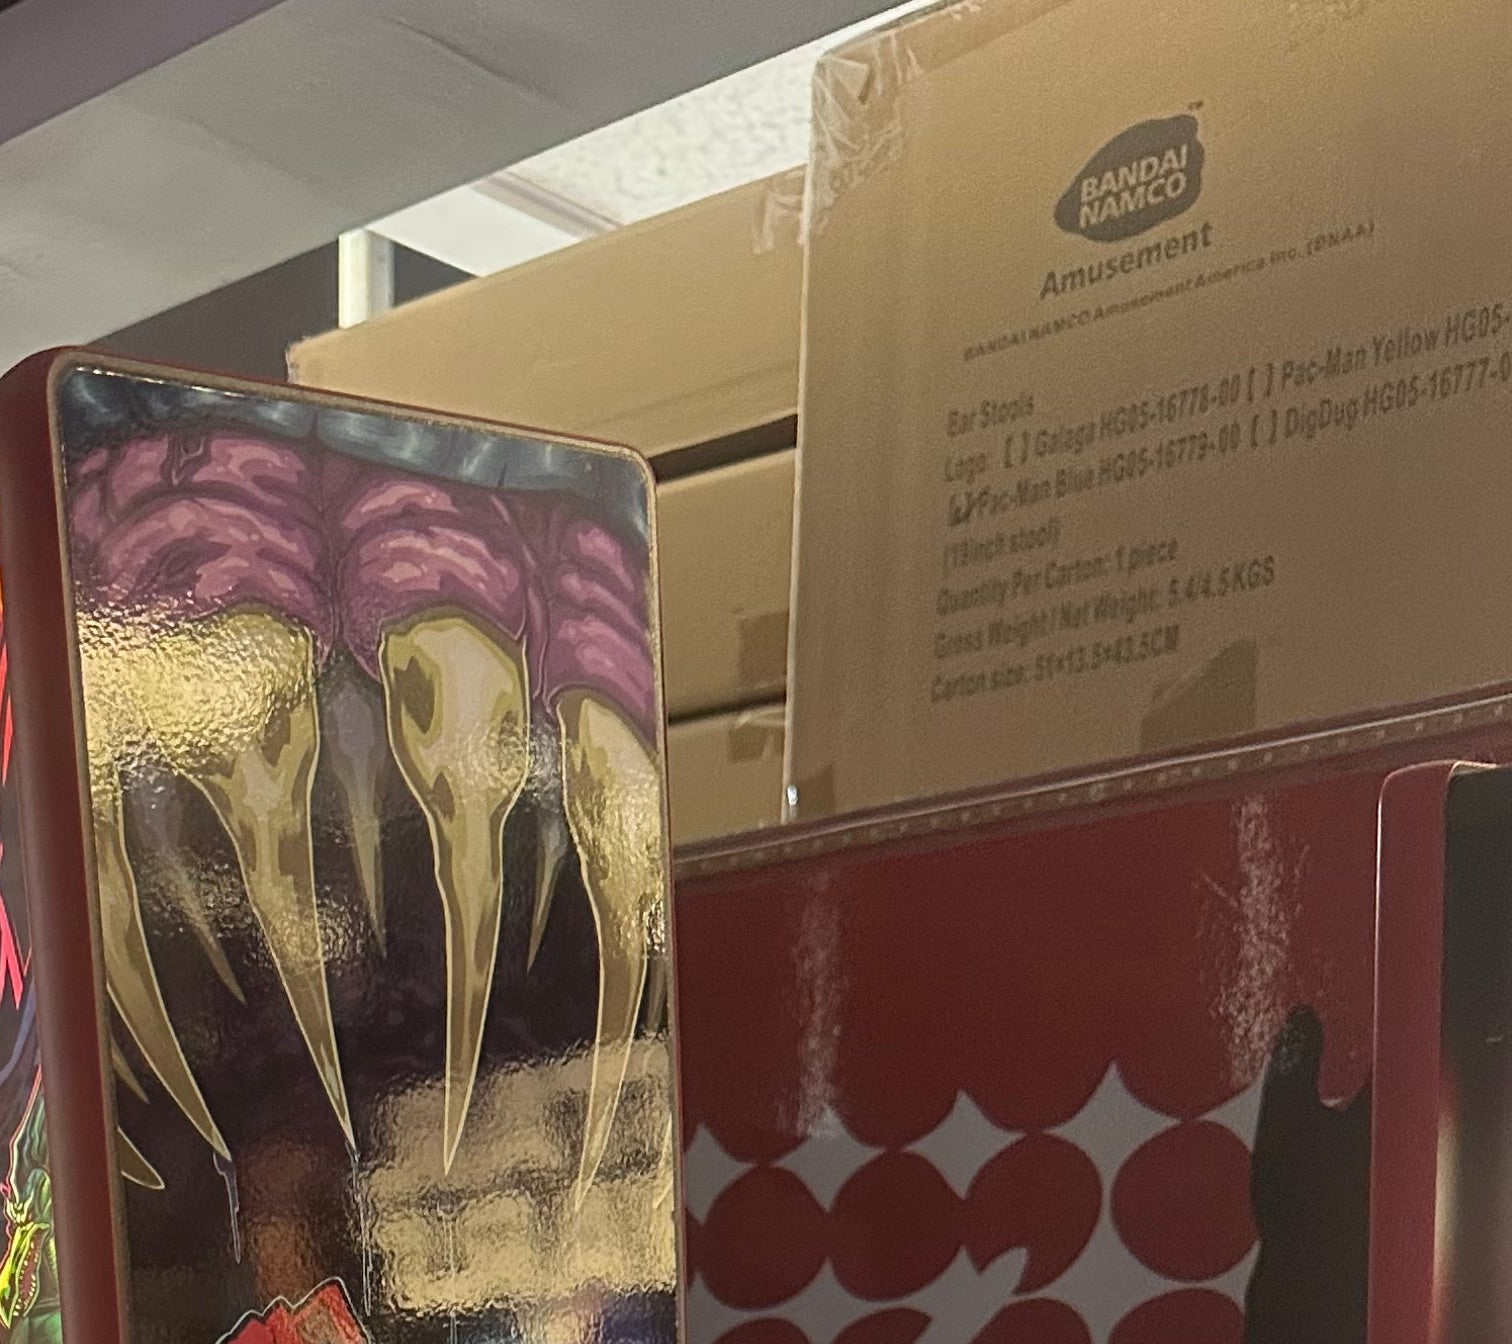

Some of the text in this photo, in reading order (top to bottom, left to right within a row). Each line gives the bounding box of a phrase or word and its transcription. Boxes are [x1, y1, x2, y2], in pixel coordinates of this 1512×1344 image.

[1080, 144, 1188, 204] BANDAI
[1080, 172, 1187, 229] NAMCO
[1040, 221, 1214, 300] Amusement
[1281, 347, 1366, 390] Pac-Man
[1371, 325, 1441, 367] Yellow
[1283, 397, 1359, 439] DigDug
